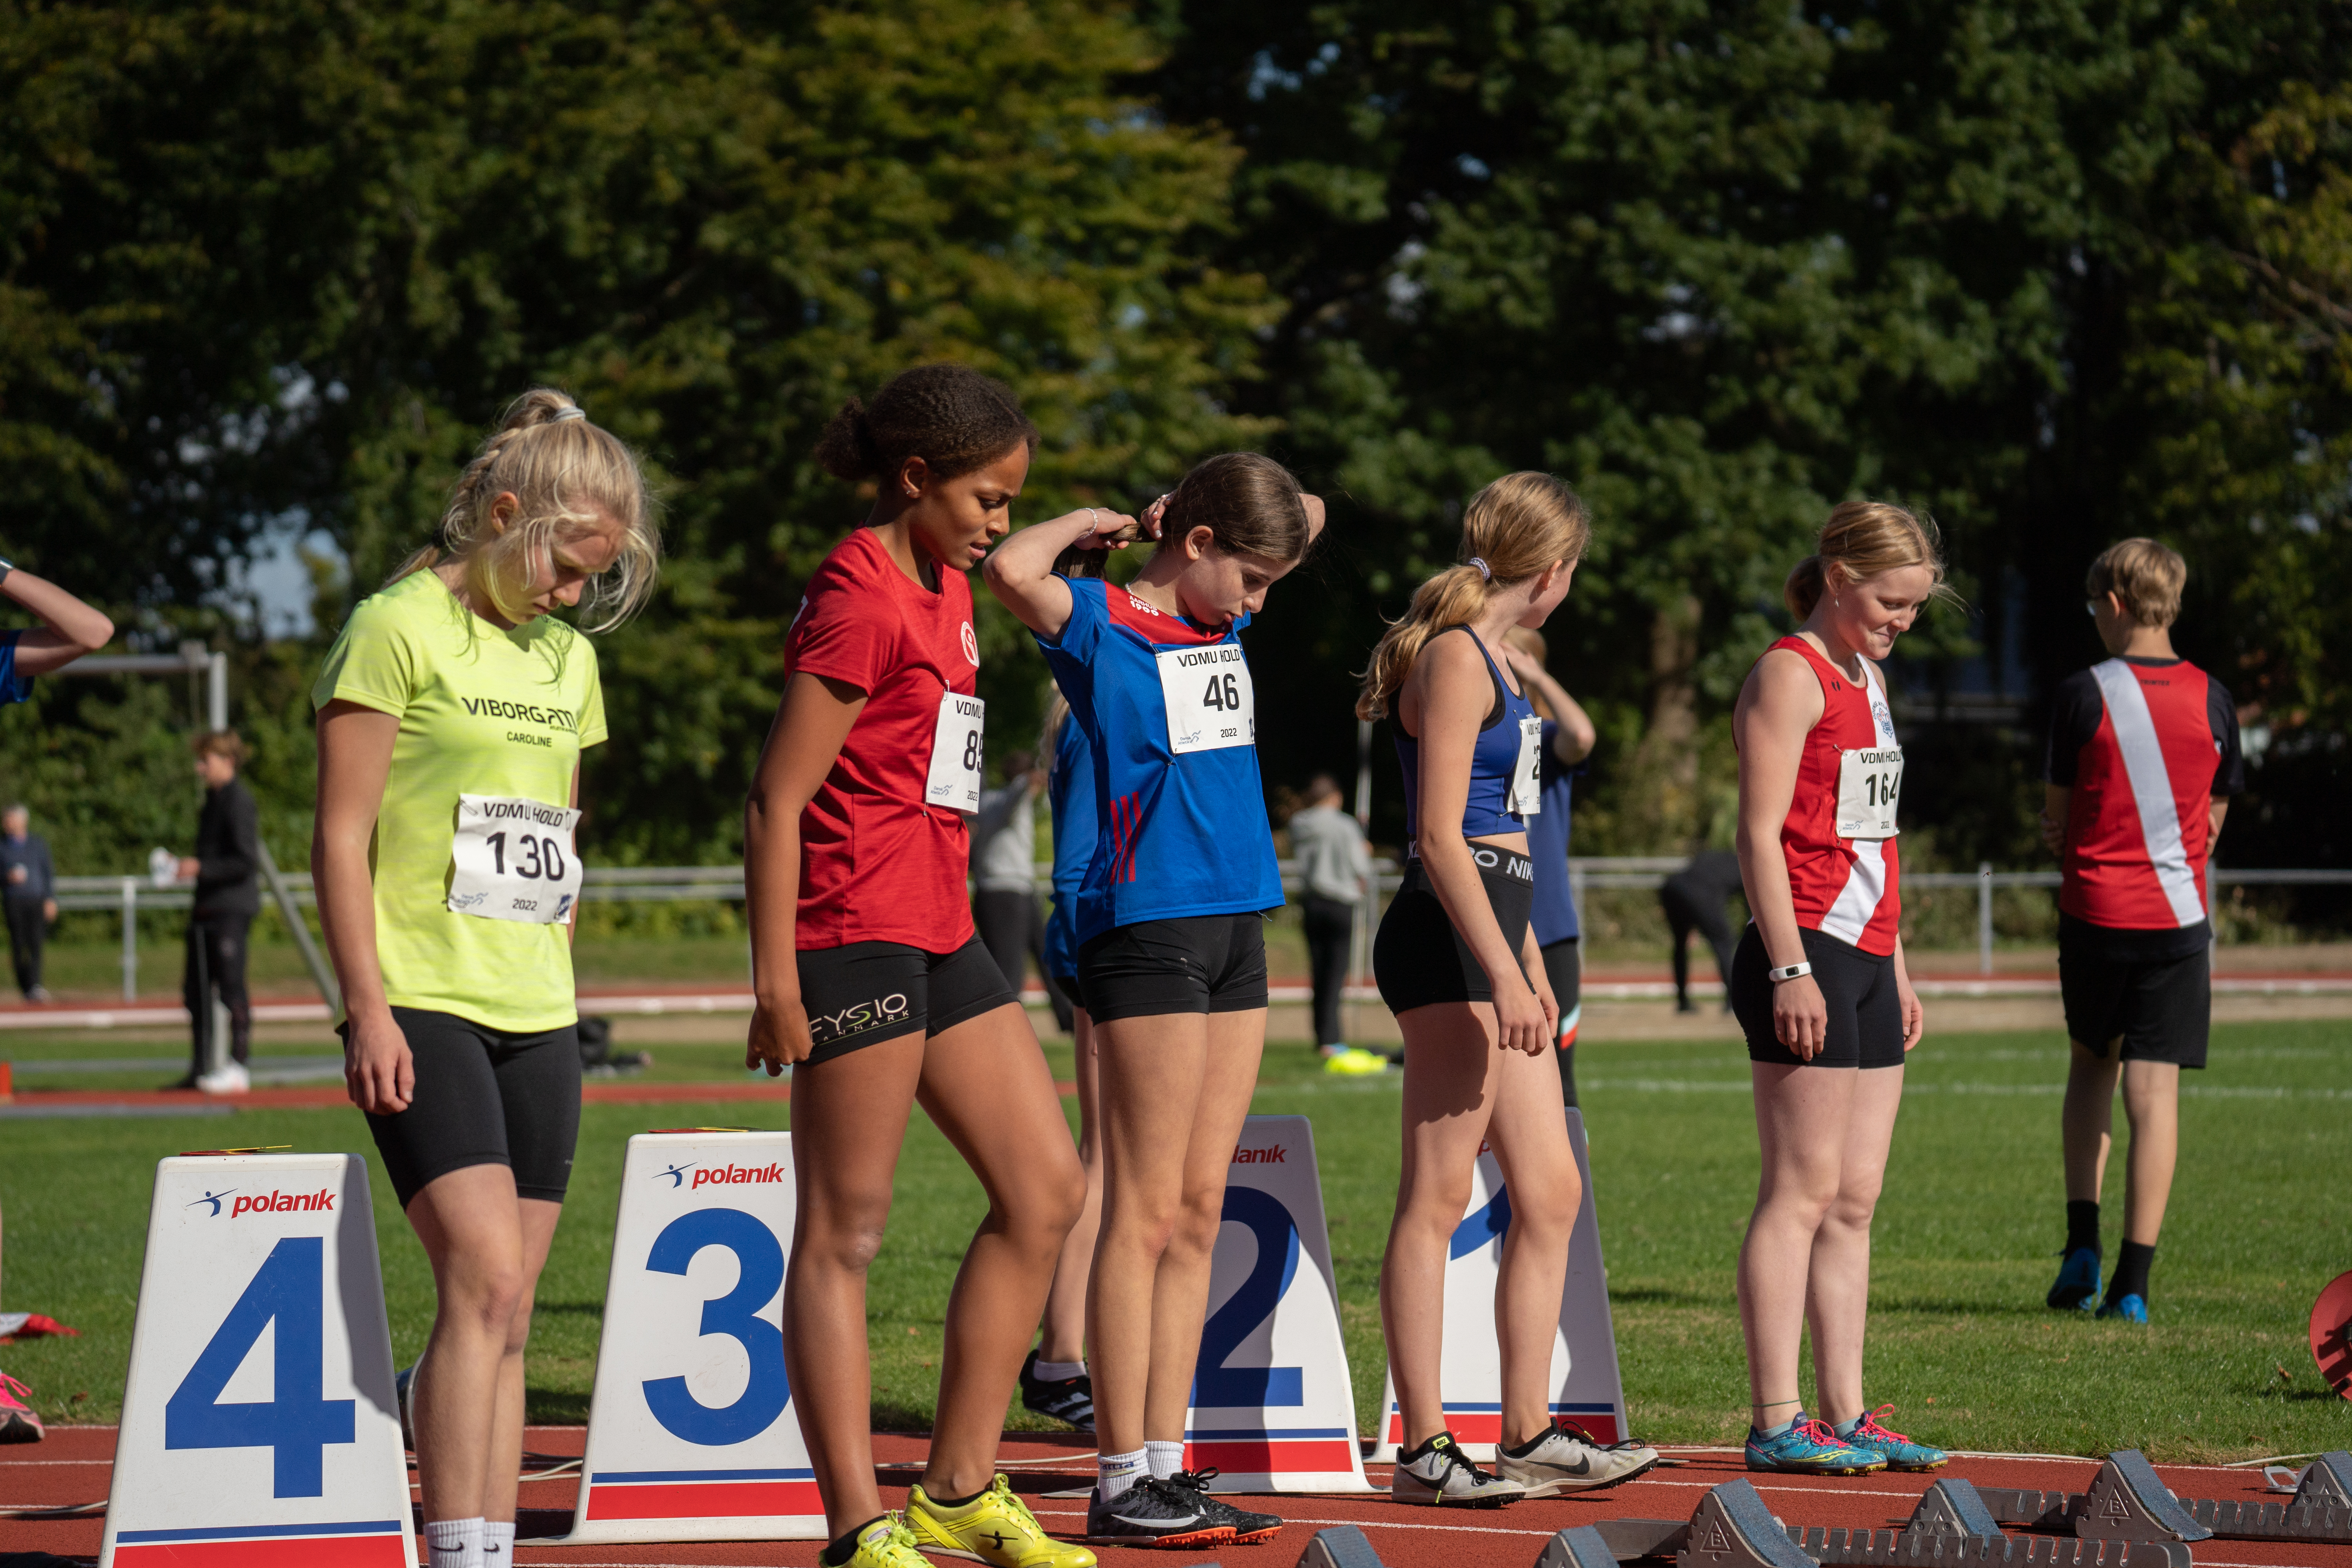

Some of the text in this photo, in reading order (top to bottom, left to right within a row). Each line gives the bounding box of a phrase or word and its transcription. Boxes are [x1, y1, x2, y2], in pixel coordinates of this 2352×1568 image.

[1130, 595, 1157, 611] AARHUS
[1130, 601, 1159, 616] 1900
[1177, 649, 1240, 667] VDMU HOLD
[1203, 673, 1240, 711] 46
[461, 697, 546, 724] VIBORG
[956, 700, 982, 719] VDMU
[507, 731, 552, 748] CAROLINE
[1220, 728, 1238, 738] 2022
[967, 790, 978, 801] 2022
[1866, 772, 1899, 806] 164
[484, 802, 563, 827] VDMU HOLD
[1881, 821, 1889, 829] 2022
[486, 831, 564, 882] 130
[1506, 857, 1534, 882] NIK
[512, 898, 538, 911] 2022
[809, 994, 907, 1041] FYSIO
[1232, 1144, 1287, 1163] lanik
[691, 1163, 784, 1190] polanik
[231, 1188, 336, 1219] polanik
[1189, 1185, 1304, 1408] 2
[642, 1208, 791, 1446] 3
[165, 1236, 356, 1499] 4
[1436, 1438, 1447, 1447] NIKE
